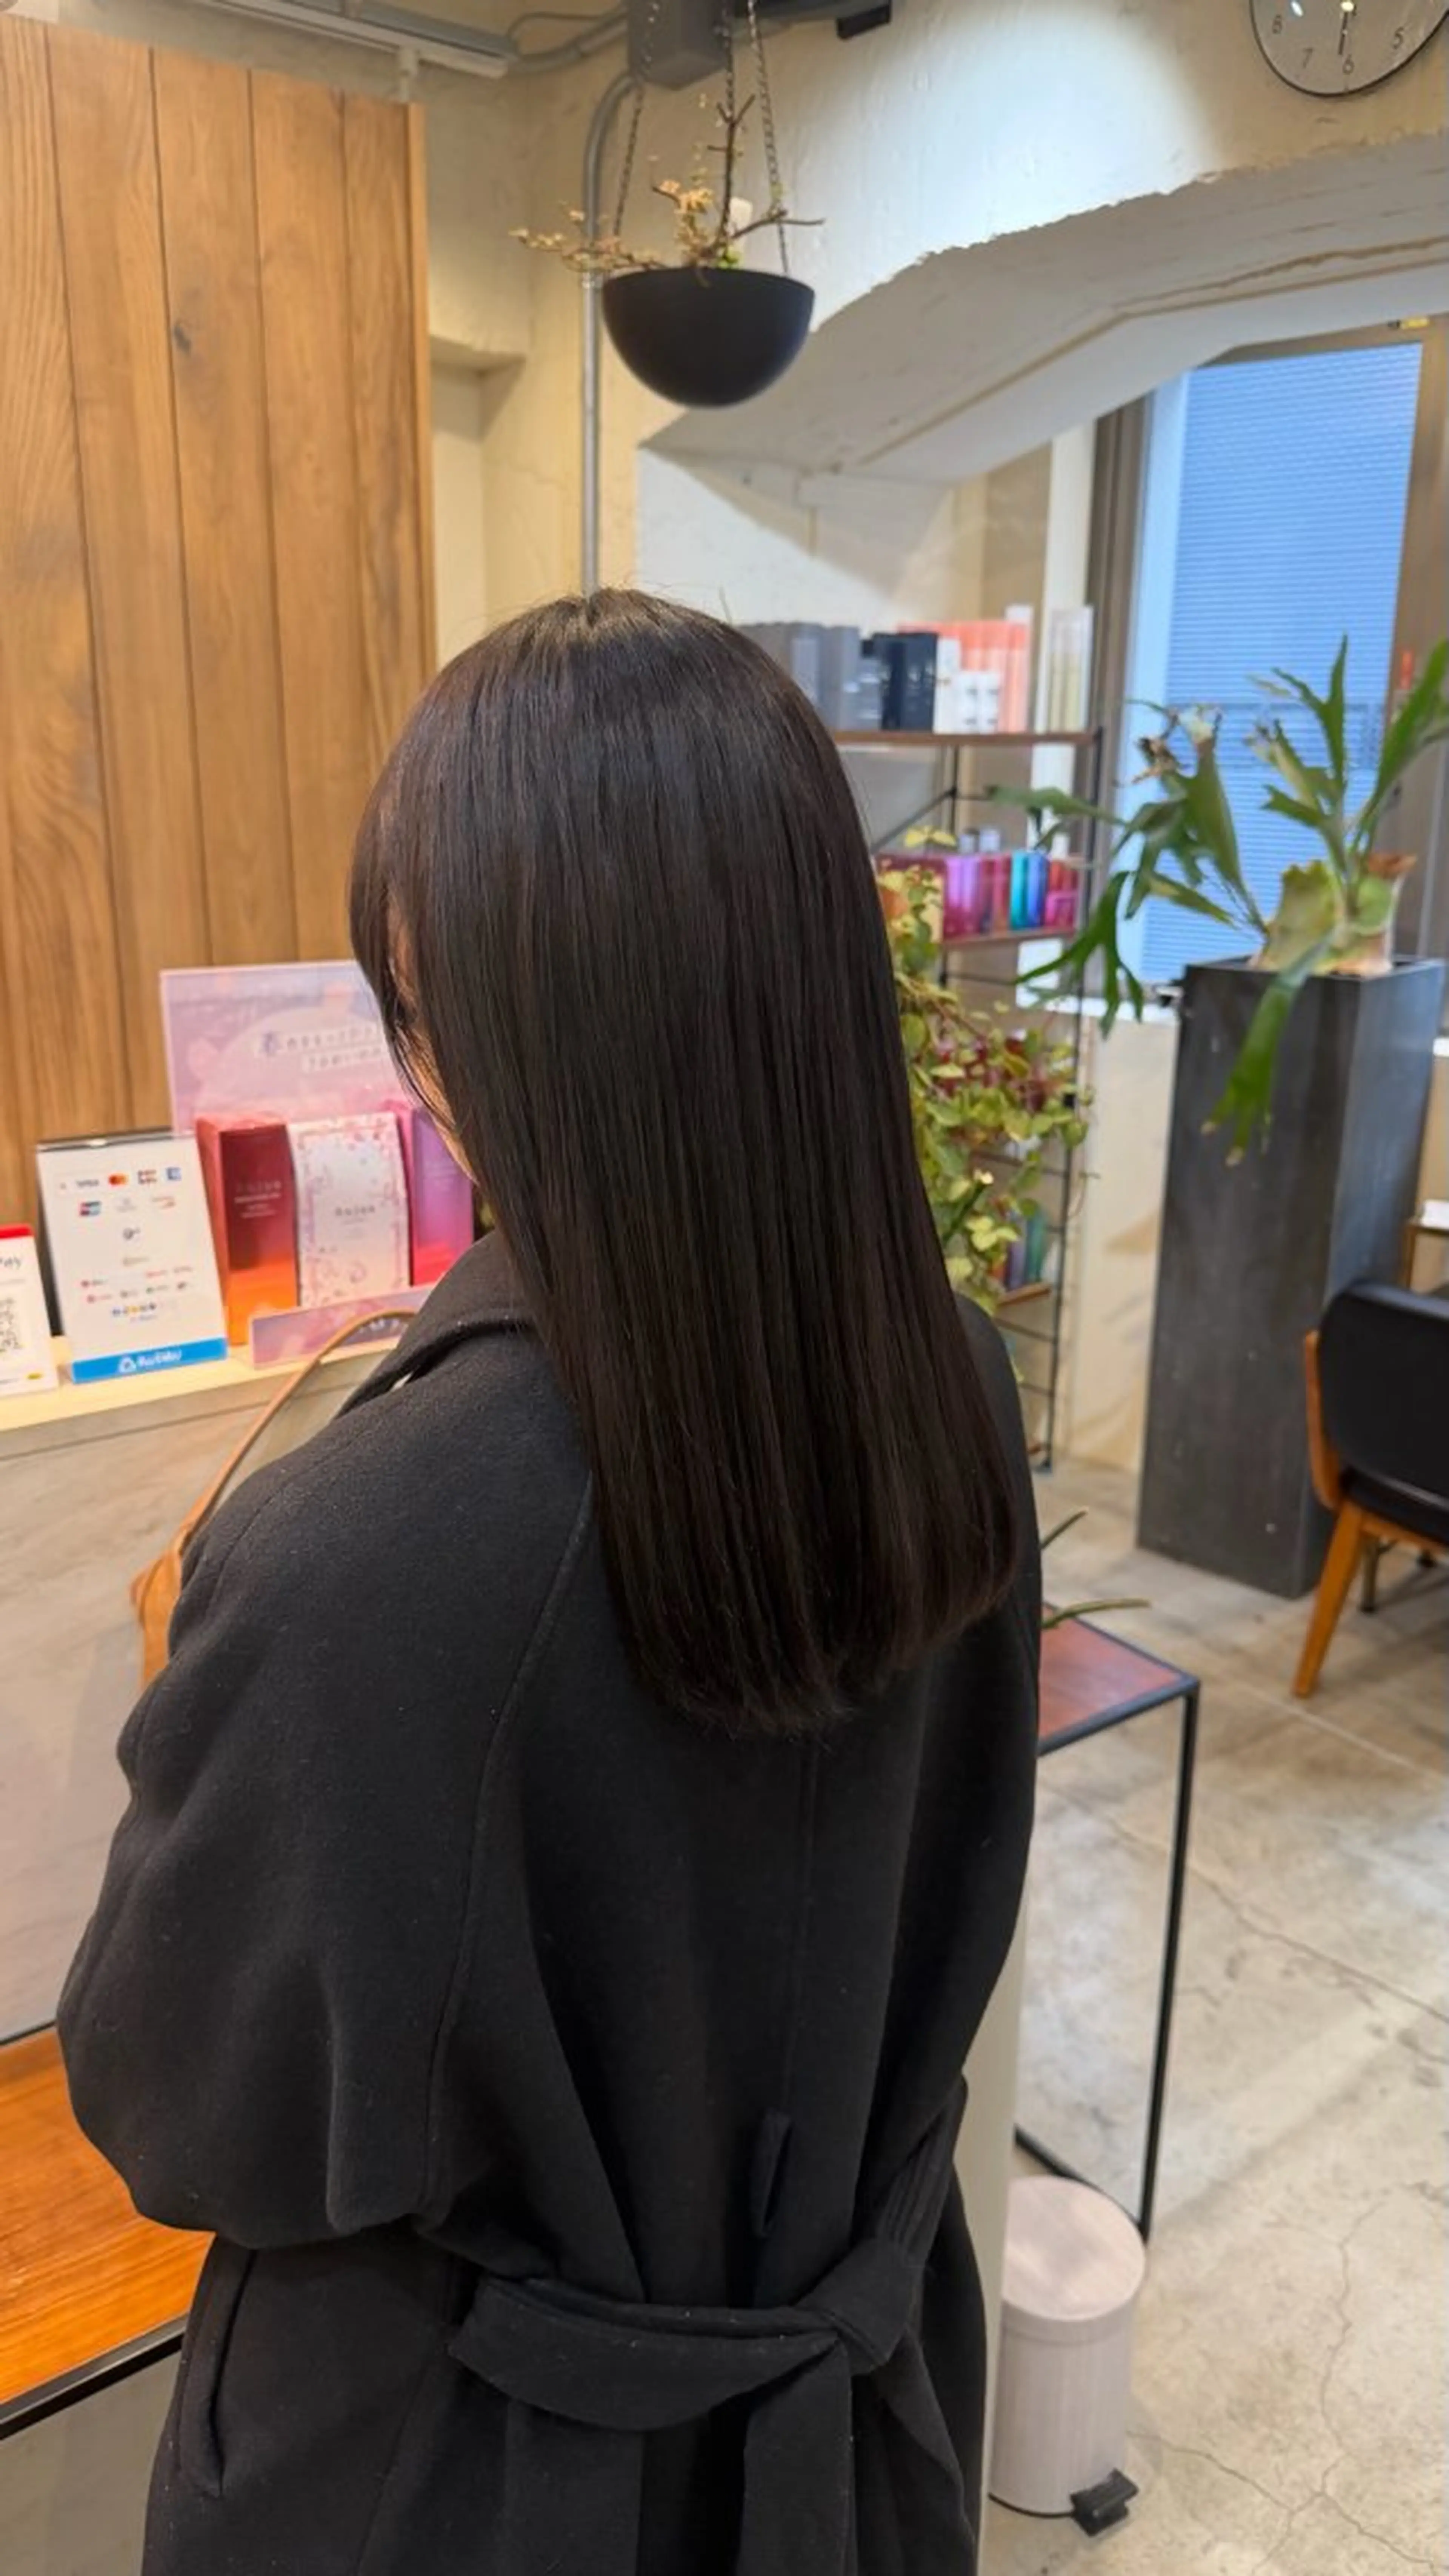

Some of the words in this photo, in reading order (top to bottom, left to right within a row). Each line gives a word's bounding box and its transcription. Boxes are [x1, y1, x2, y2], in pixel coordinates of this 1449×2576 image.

[1272, 14, 1282, 34] 8
[1393, 26, 1404, 49] 5
[1302, 47, 1314, 69] 7
[1342, 54, 1355, 74] 6
